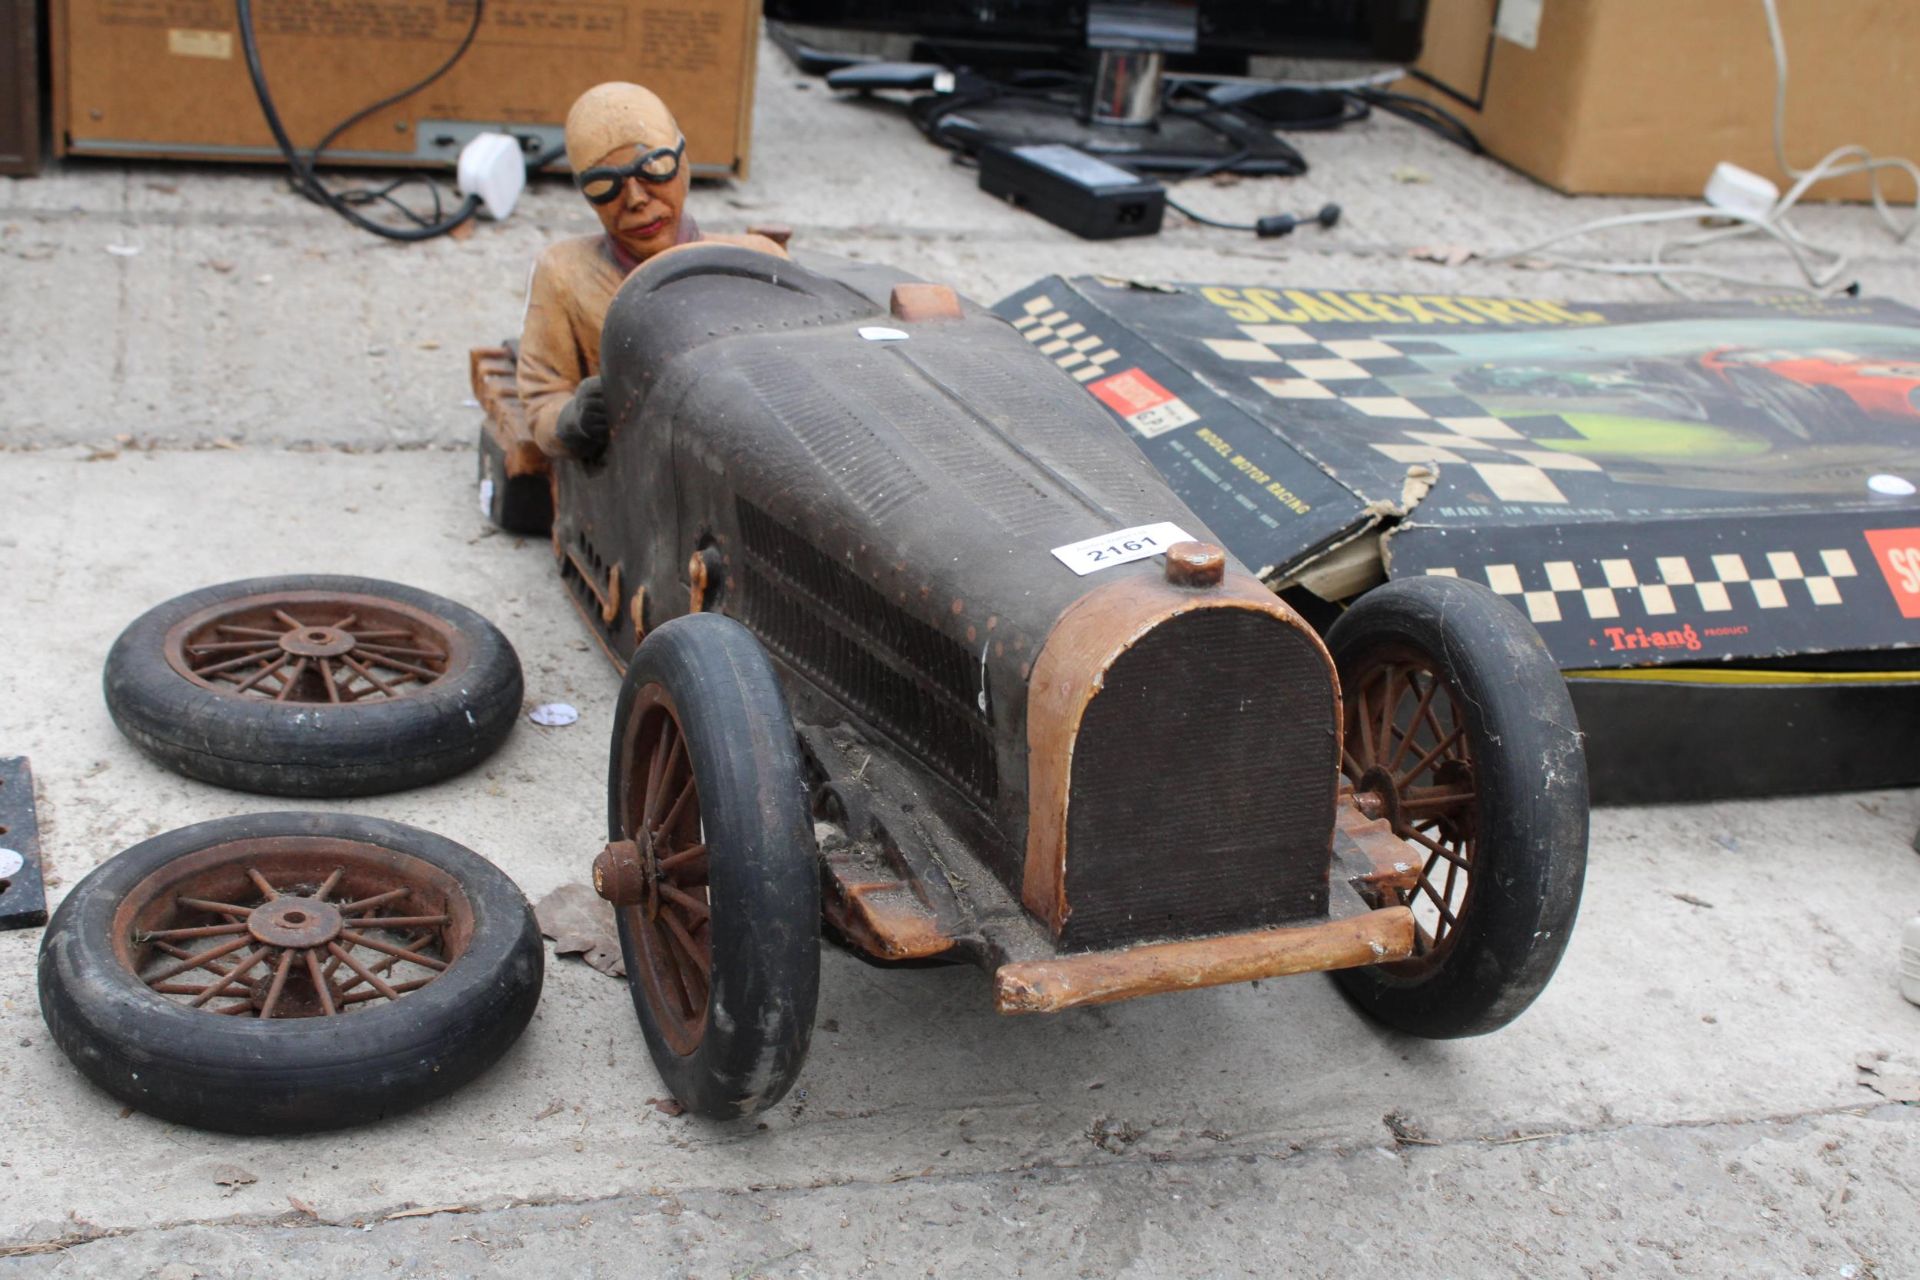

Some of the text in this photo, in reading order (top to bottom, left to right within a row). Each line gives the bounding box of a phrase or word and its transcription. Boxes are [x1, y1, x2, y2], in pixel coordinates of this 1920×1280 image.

[1201, 286, 1609, 324] SCALEXTRIC
[1194, 427, 1233, 458] MODEL
[1229, 454, 1271, 485] MOTOR
[1265, 482, 1312, 515] RACING
[1439, 506, 1492, 517] MADE
[1503, 505, 1523, 515] IN
[1531, 506, 1615, 517] ENGLAND
[1087, 536, 1158, 563] 2161
[1704, 625, 1749, 637] PRODUCT
